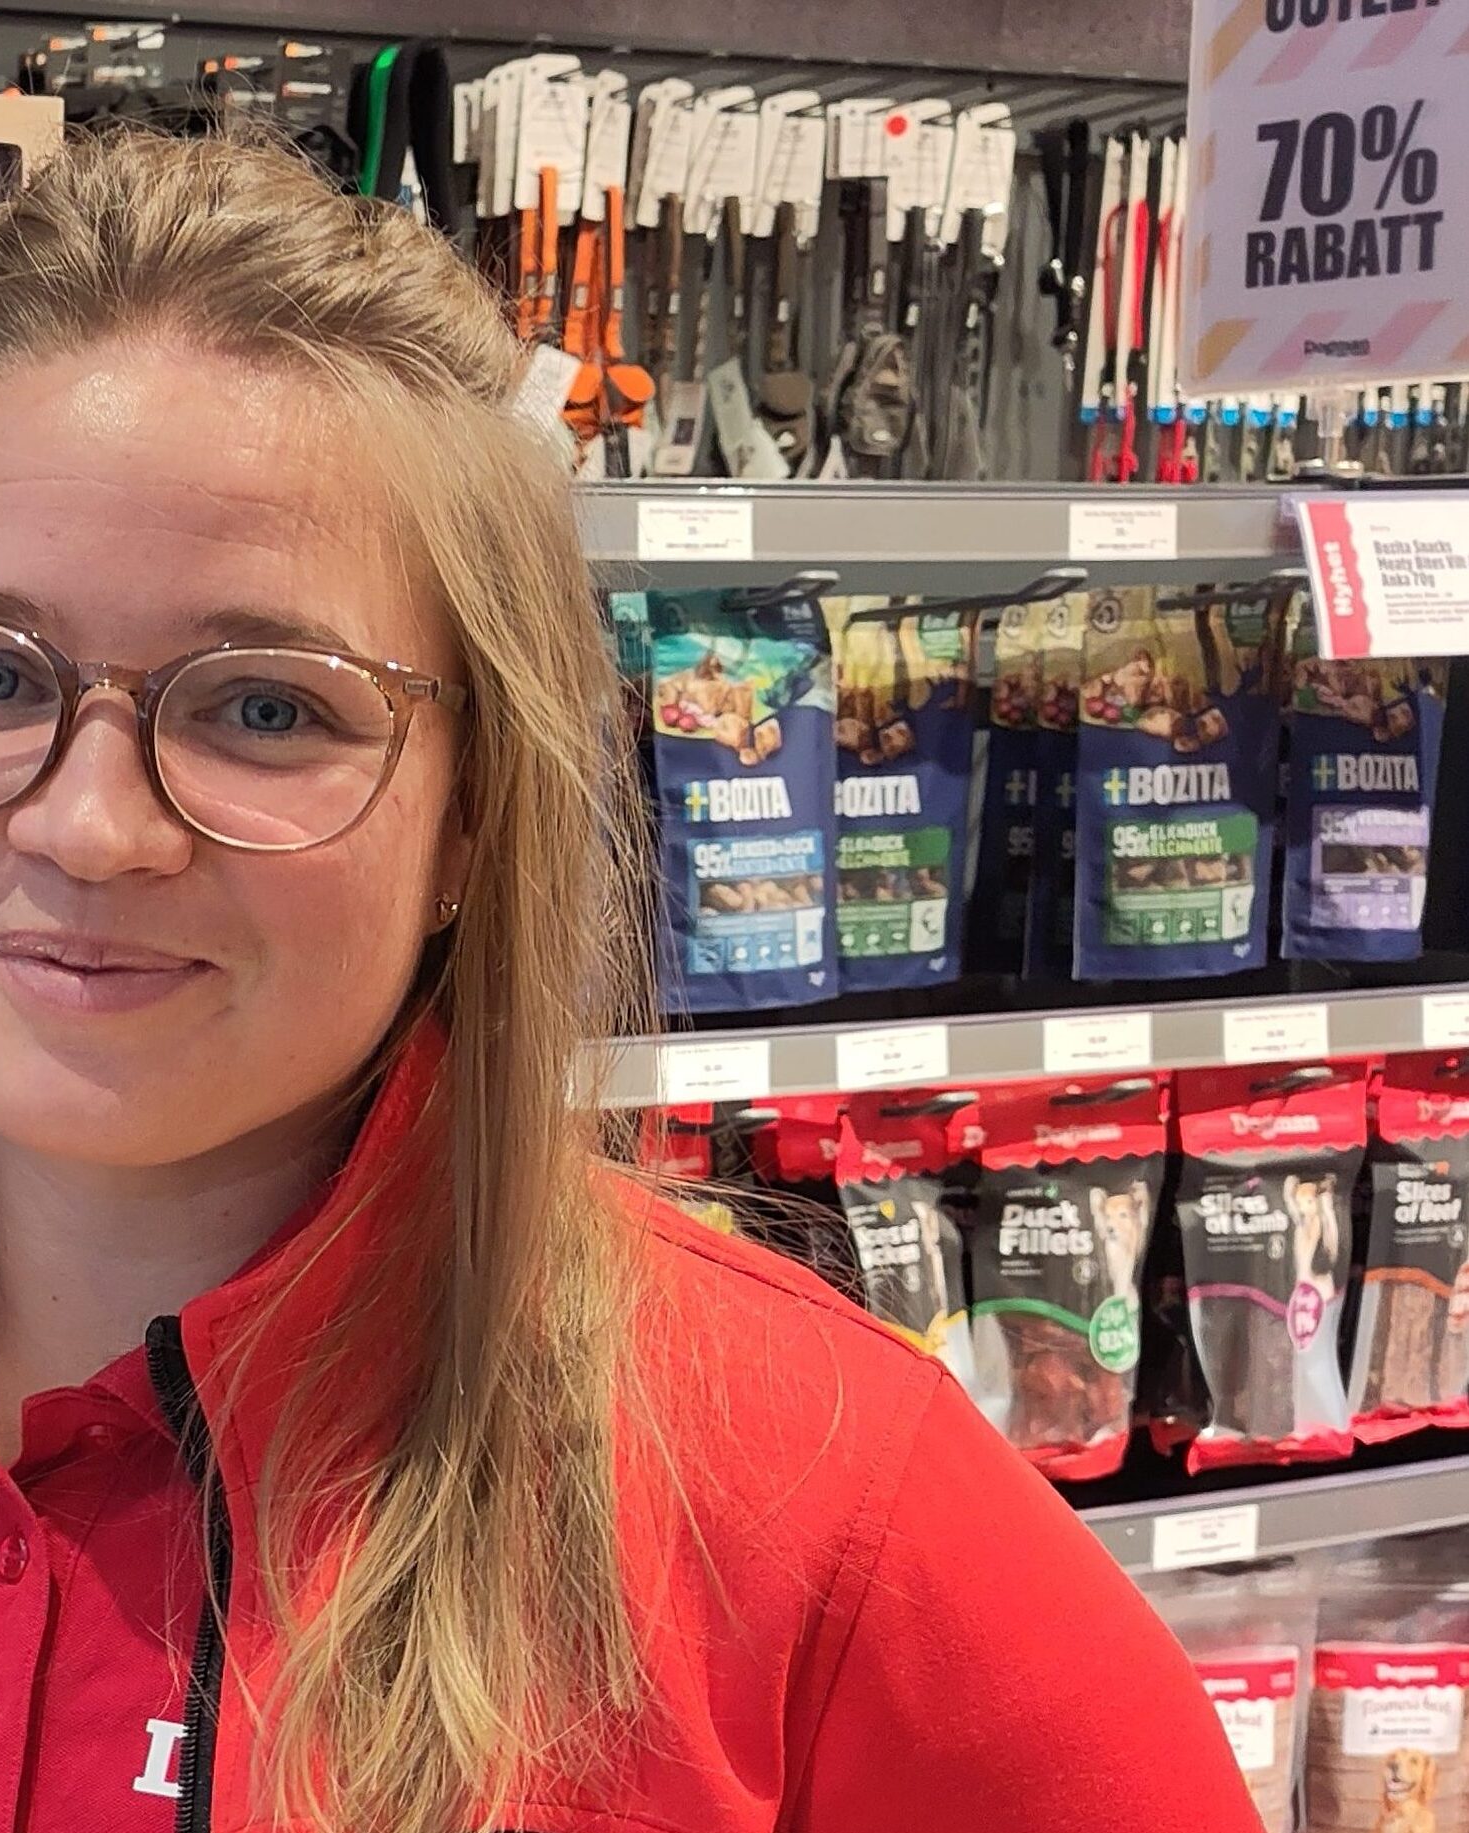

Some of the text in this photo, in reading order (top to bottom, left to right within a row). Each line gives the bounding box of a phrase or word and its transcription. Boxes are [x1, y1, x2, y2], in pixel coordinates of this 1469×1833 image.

[1257, 99, 1438, 222] 70%
[1245, 211, 1444, 289] RABATT
[1128, 763, 1231, 805] BOZITA
[1336, 753, 1419, 791] BOZITA
[707, 775, 793, 822] BOZITA
[1001, 1200, 1081, 1229] Duck
[999, 1227, 1094, 1256] Fillets
